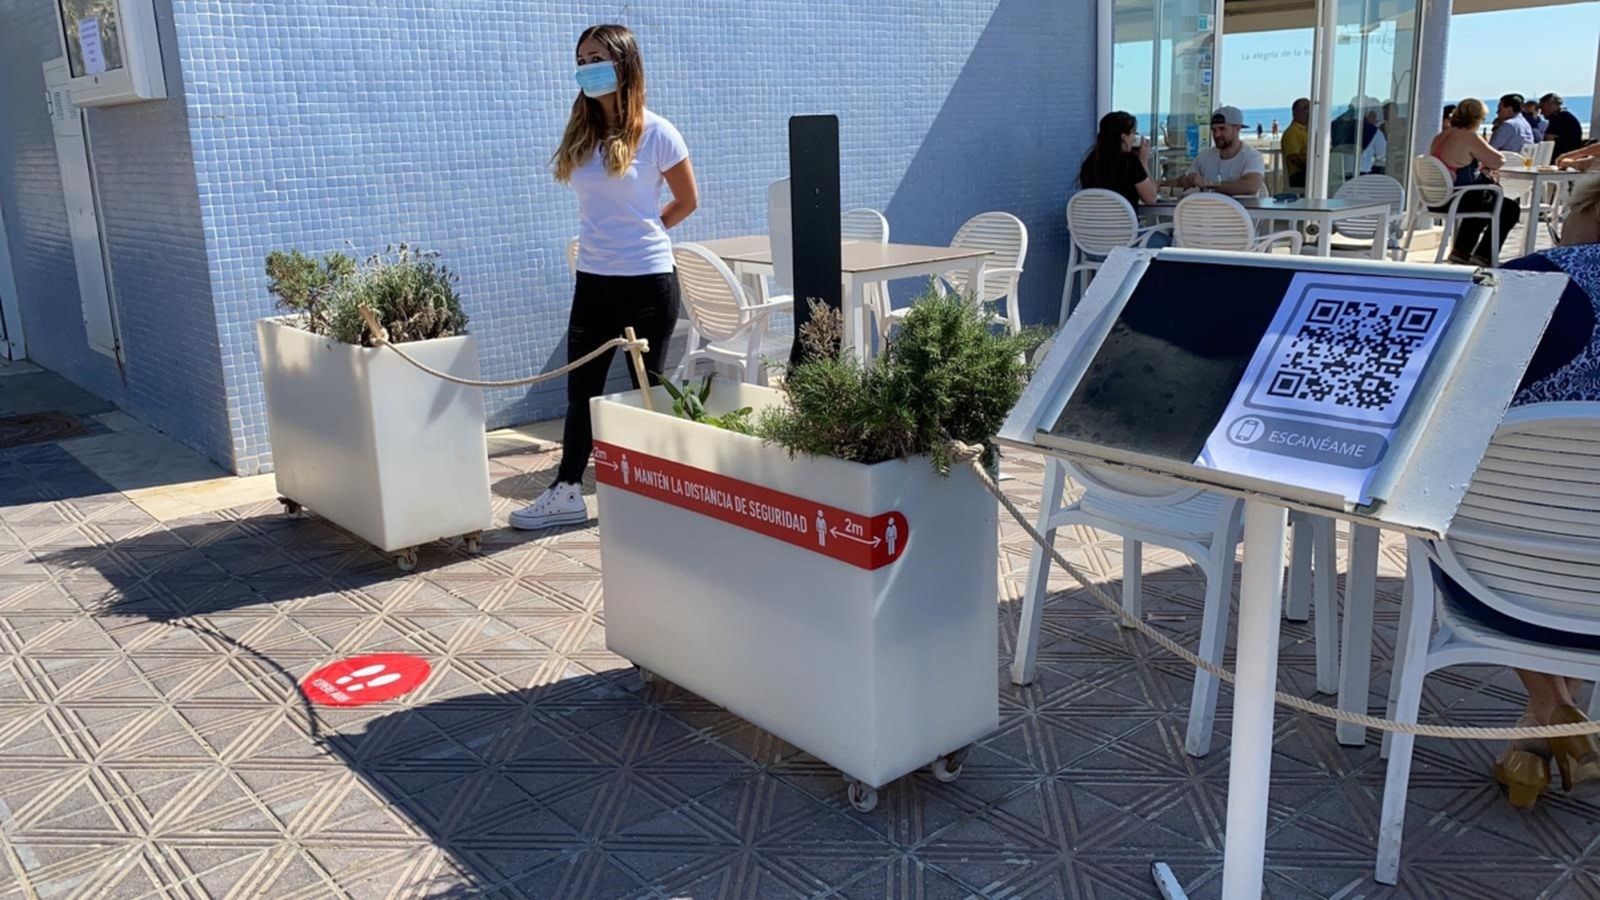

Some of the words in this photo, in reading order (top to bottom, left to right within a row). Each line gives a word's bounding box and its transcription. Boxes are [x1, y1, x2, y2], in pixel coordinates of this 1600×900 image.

[1268, 430, 1367, 457] ESCANÉAME
[634, 466, 670, 491] MANTÉN
[671, 477, 684, 495] LA
[685, 481, 733, 511] DISTANCIA
[734, 496, 748, 515] DE
[749, 500, 808, 533] SEGURIDAD
[845, 518, 864, 536] 2m
